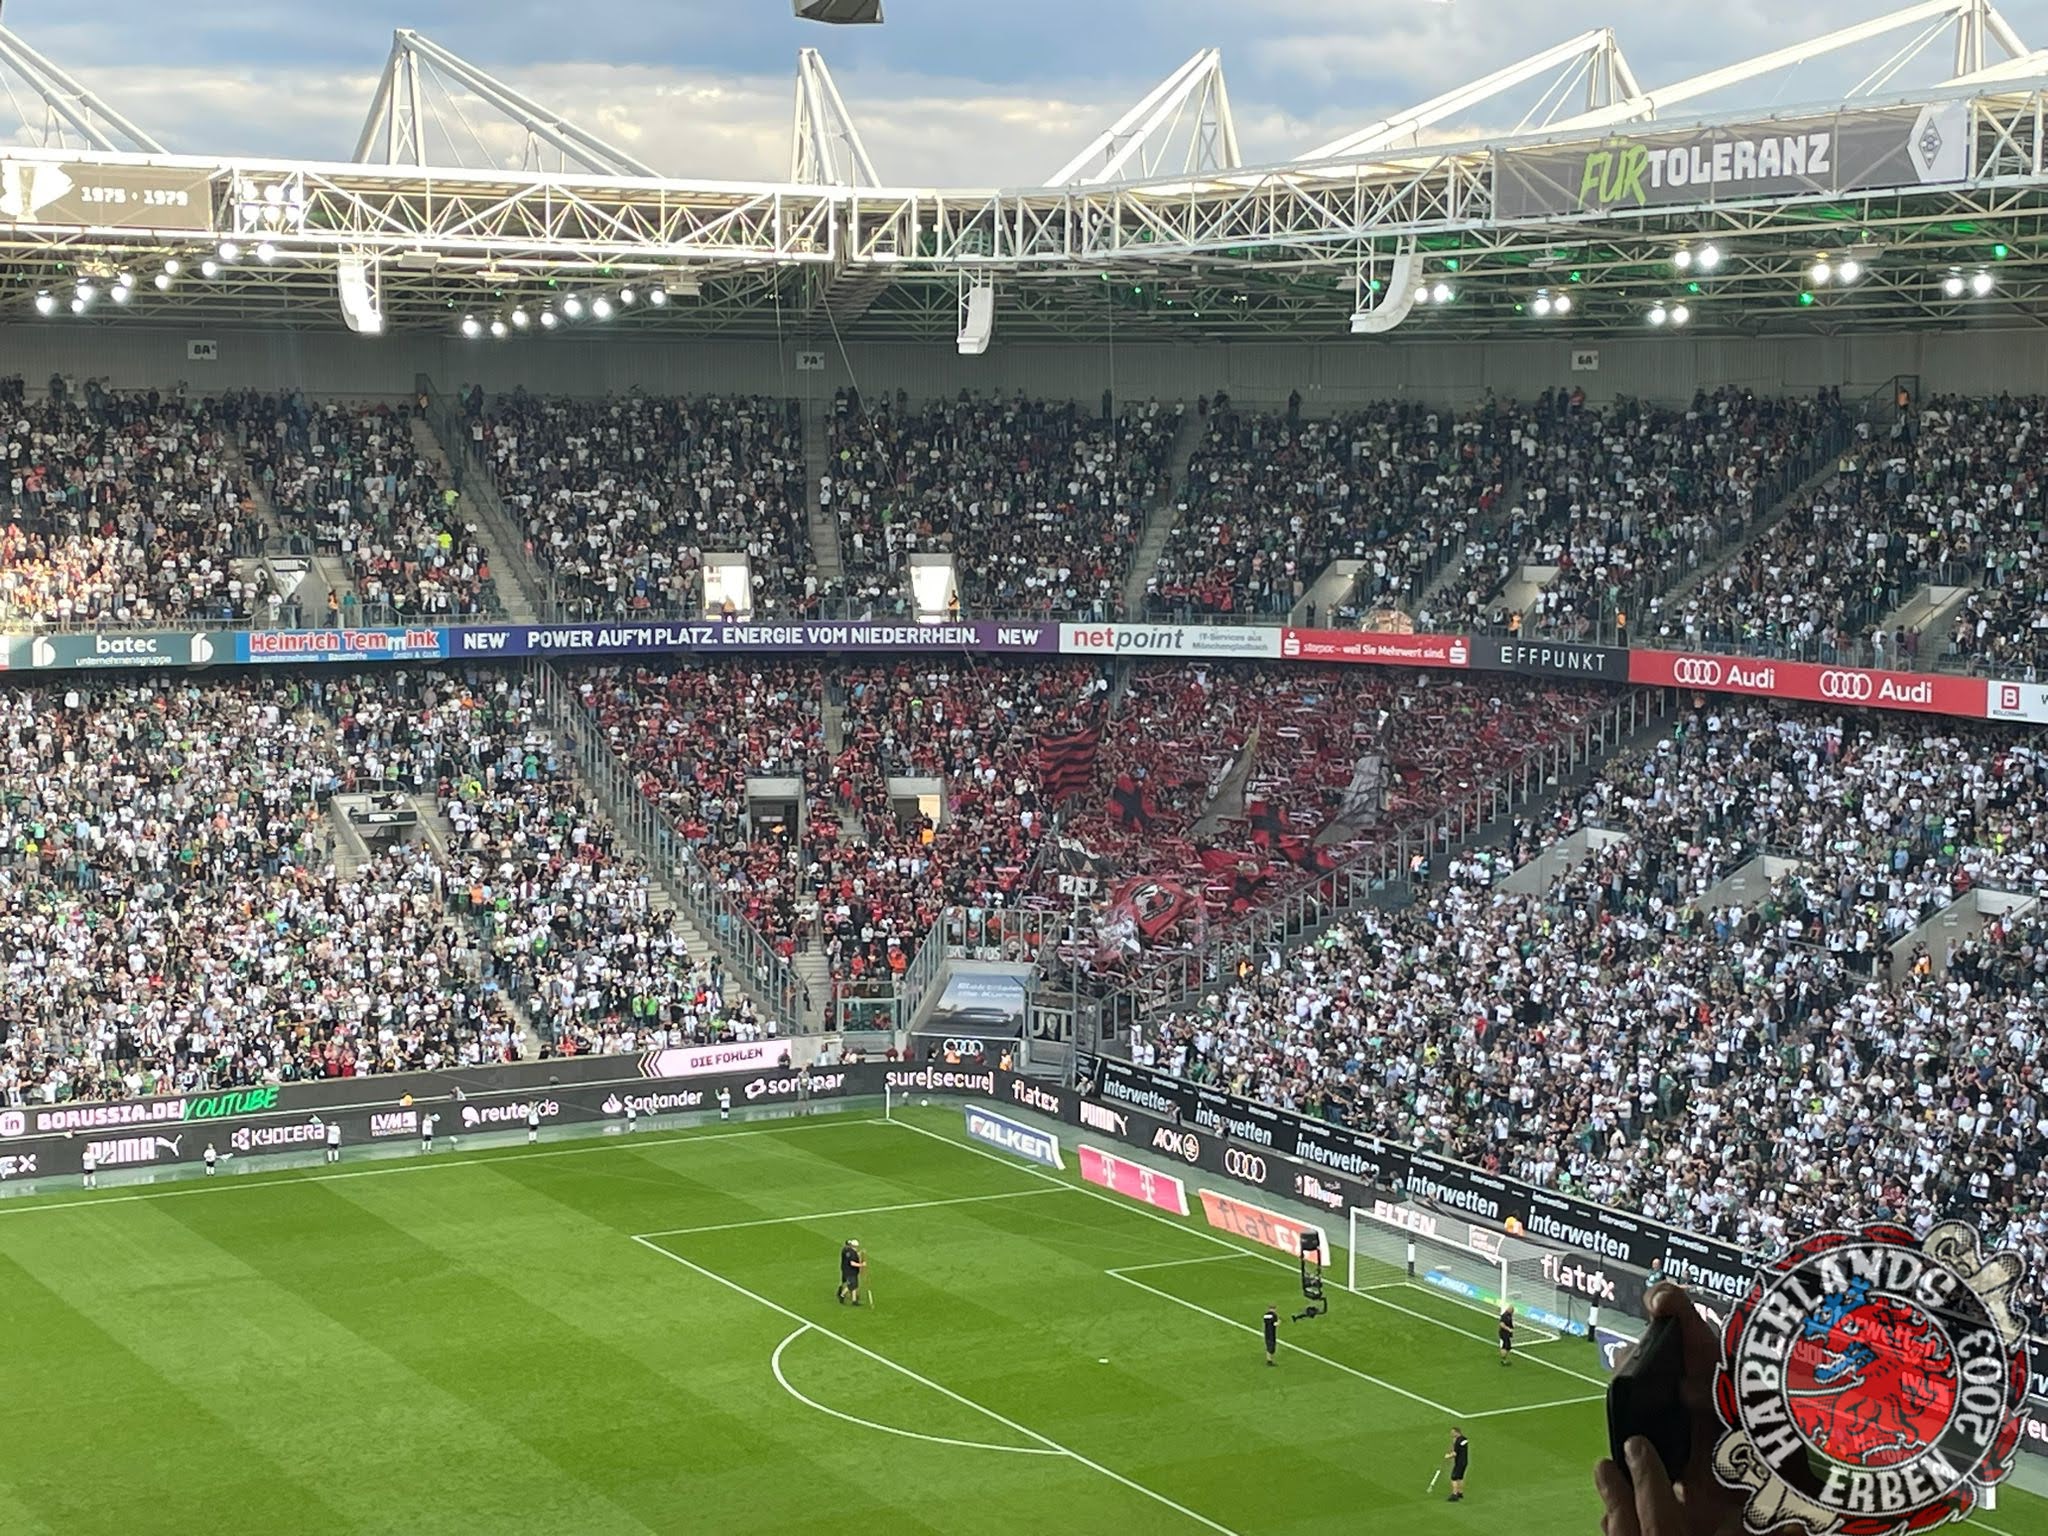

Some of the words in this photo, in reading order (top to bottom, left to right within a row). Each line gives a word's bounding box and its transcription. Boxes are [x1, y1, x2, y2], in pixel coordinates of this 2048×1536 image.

[1578, 136, 1649, 208] FÜR
[1648, 133, 1830, 188] TOLERANZ
[81, 186, 126, 203] 1975
[143, 189, 188, 206] 1979
[96, 635, 157, 654] batec
[250, 633, 339, 653] Heinrich
[527, 630, 594, 648] POWER
[655, 628, 718, 645] PLATZ.
[722, 627, 804, 645] ENERGIE
[807, 626, 847, 644] VOM
[851, 626, 980, 644] NIEDERRHEIN.
[1074, 627, 1184, 651] netpoint
[1501, 646, 1605, 672] EFFPUNKT
[1726, 665, 1775, 689] Audi
[1877, 678, 1932, 703] Audi
[690, 1055, 713, 1068] DIE
[371, 1112, 402, 1130] LVM
[251, 1123, 325, 1146] KYOCERA
[969, 1114, 1053, 1162] FALKEN
[1152, 1127, 1184, 1155] AOK
[1406, 1167, 1499, 1218] interwetten
[1527, 1205, 1630, 1260] interwetten
